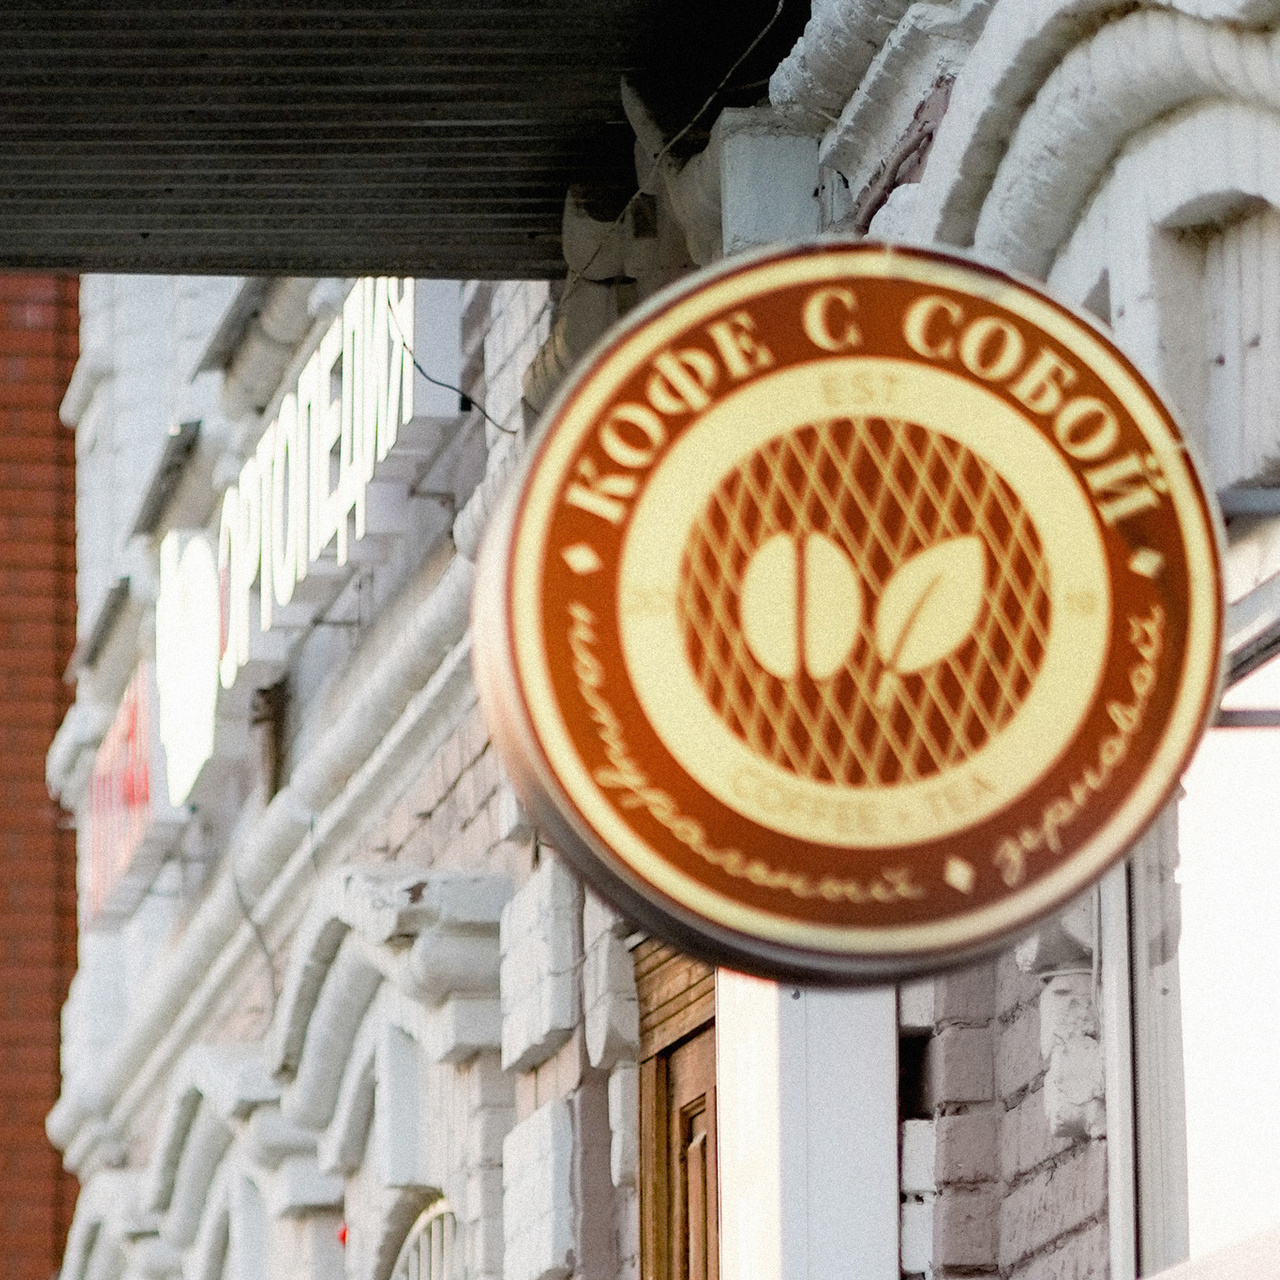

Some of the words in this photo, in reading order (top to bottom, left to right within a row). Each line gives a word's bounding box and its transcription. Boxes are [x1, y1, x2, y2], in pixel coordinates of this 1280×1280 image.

[218, 277, 416, 690] ОРТОПЕДИЯ
[566, 309, 776, 524] КОФЕ
[803, 286, 864, 353] С
[902, 295, 1169, 526] СОБОЙ
[983, 604, 1166, 888] зерновой
